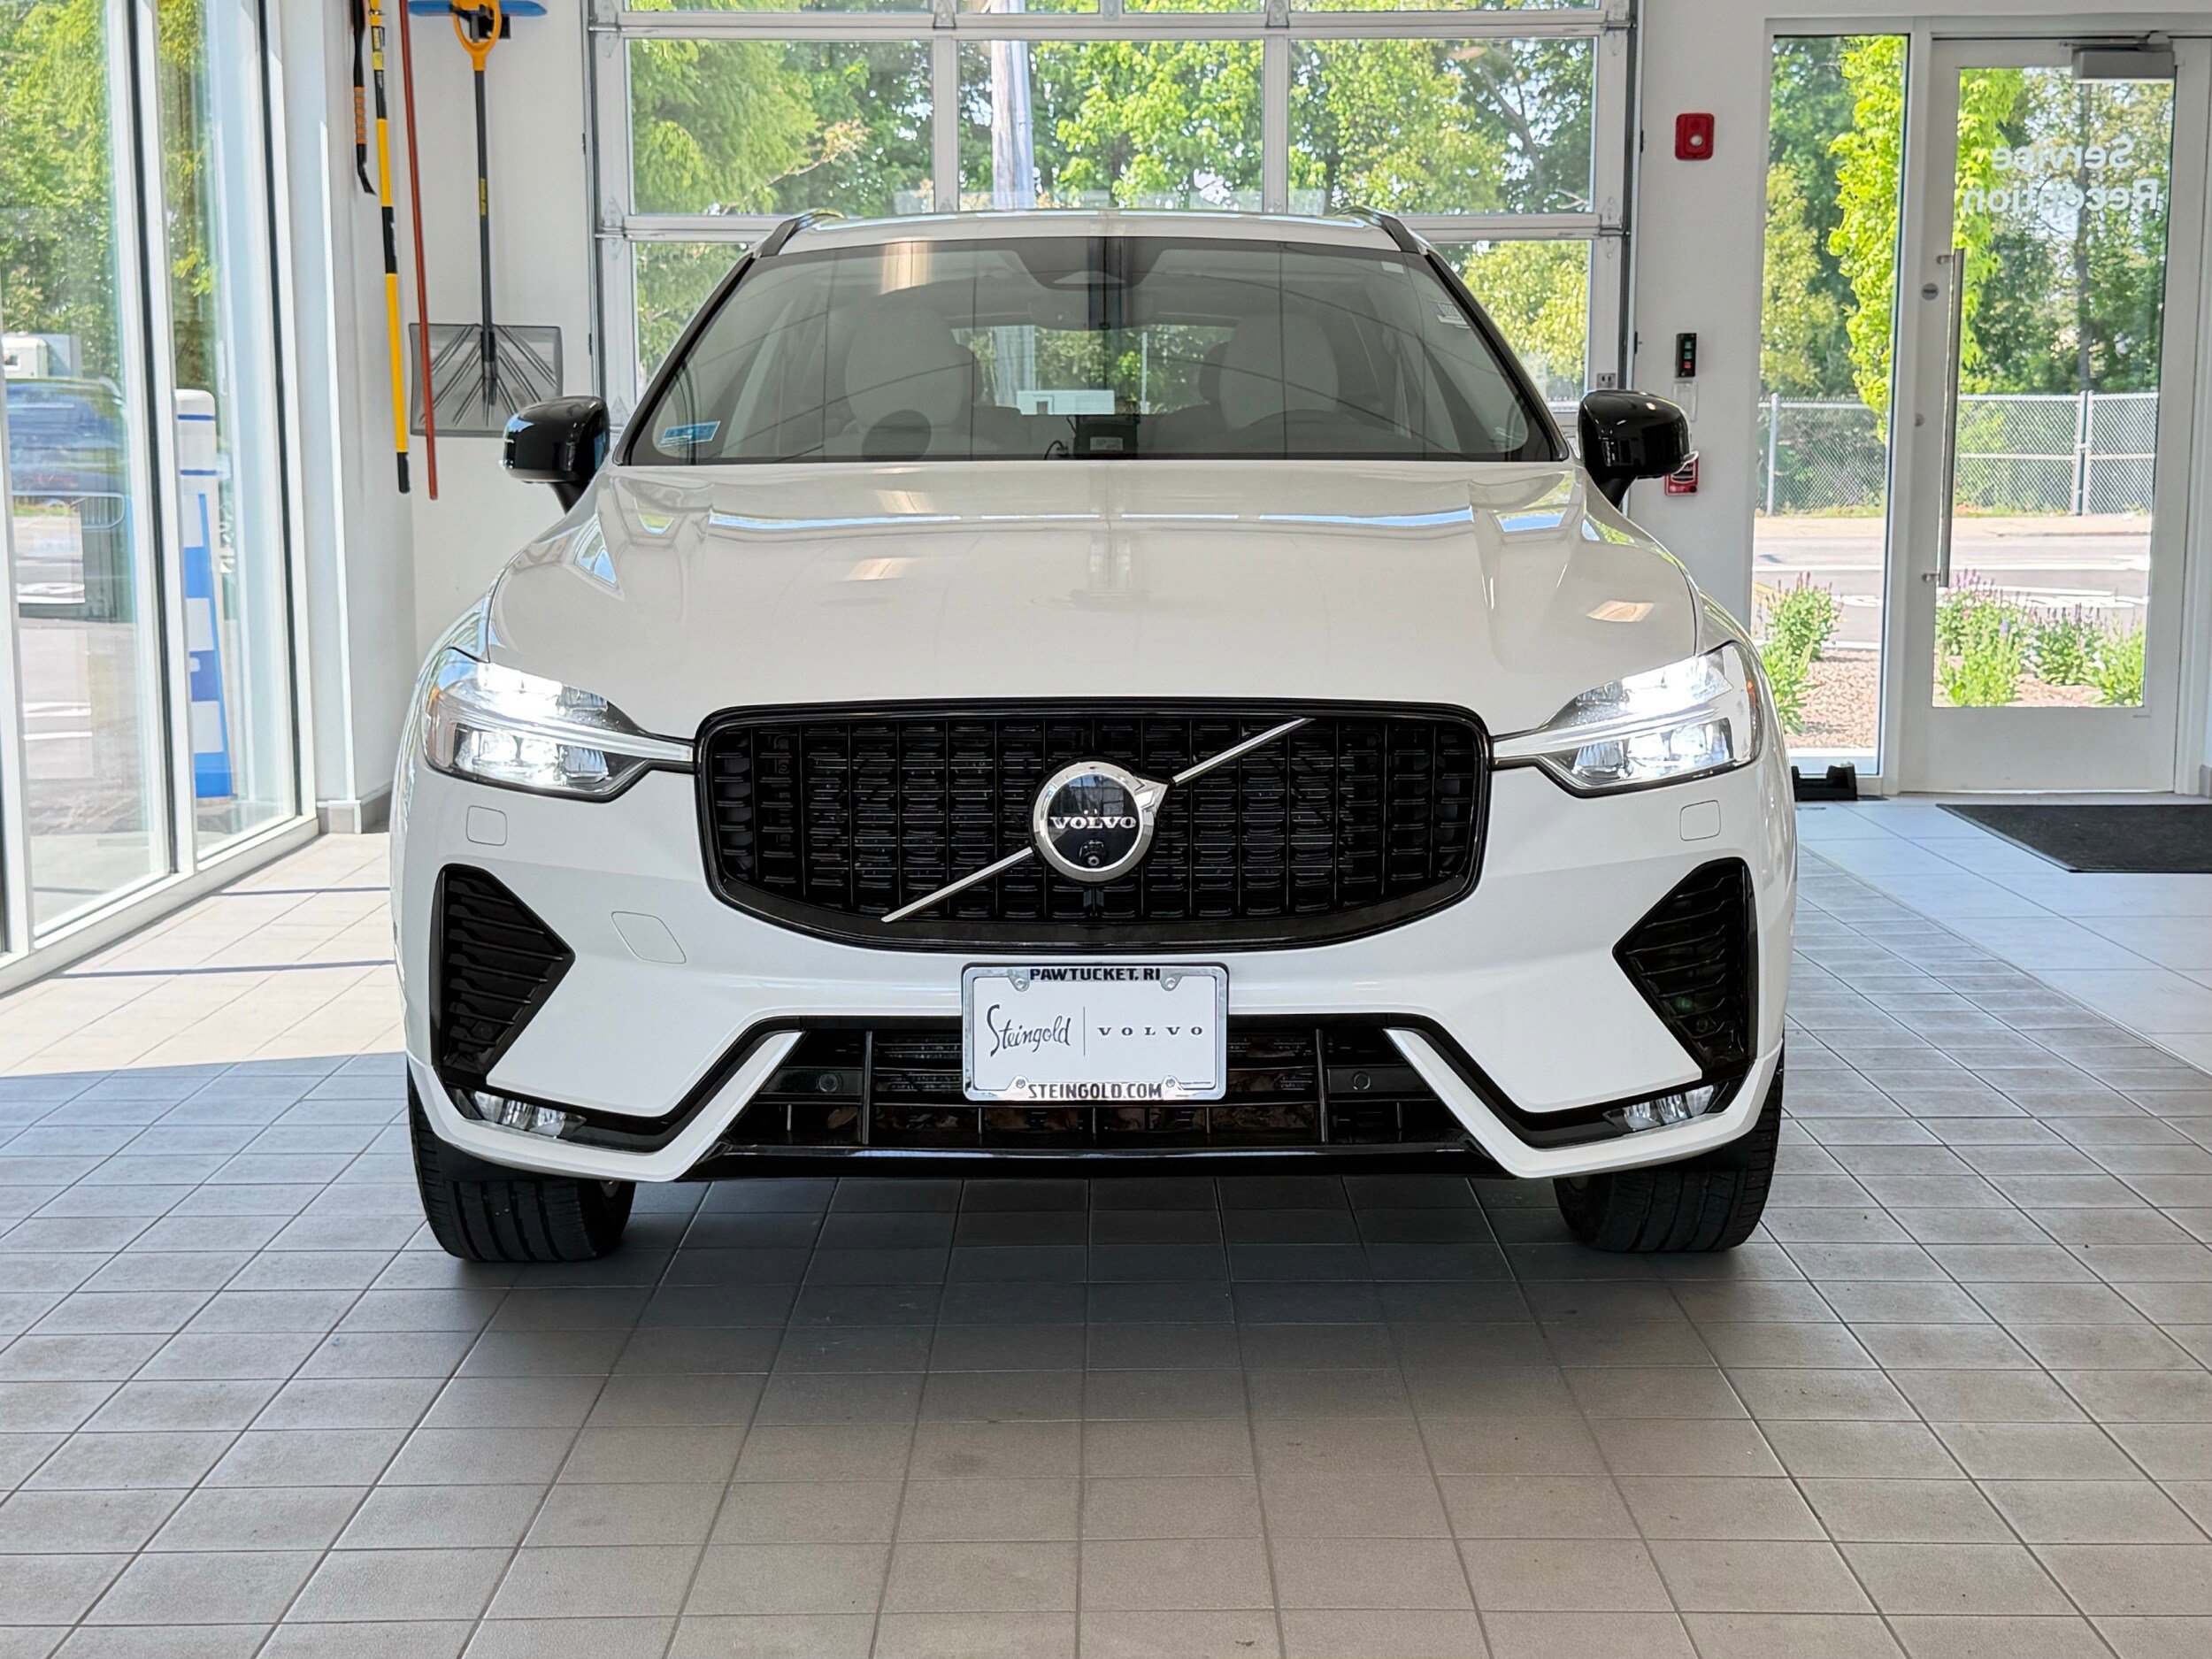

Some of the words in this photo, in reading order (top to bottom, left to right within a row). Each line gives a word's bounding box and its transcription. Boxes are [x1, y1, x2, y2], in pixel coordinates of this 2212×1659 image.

[1050, 816, 1136, 829] VOLVO
[1143, 968, 1161, 980] RI
[987, 1004, 1071, 1057] Steingold
[1096, 1026, 1203, 1036] VOLVO
[1027, 1083, 1163, 1099] STEINGOLD.COM
